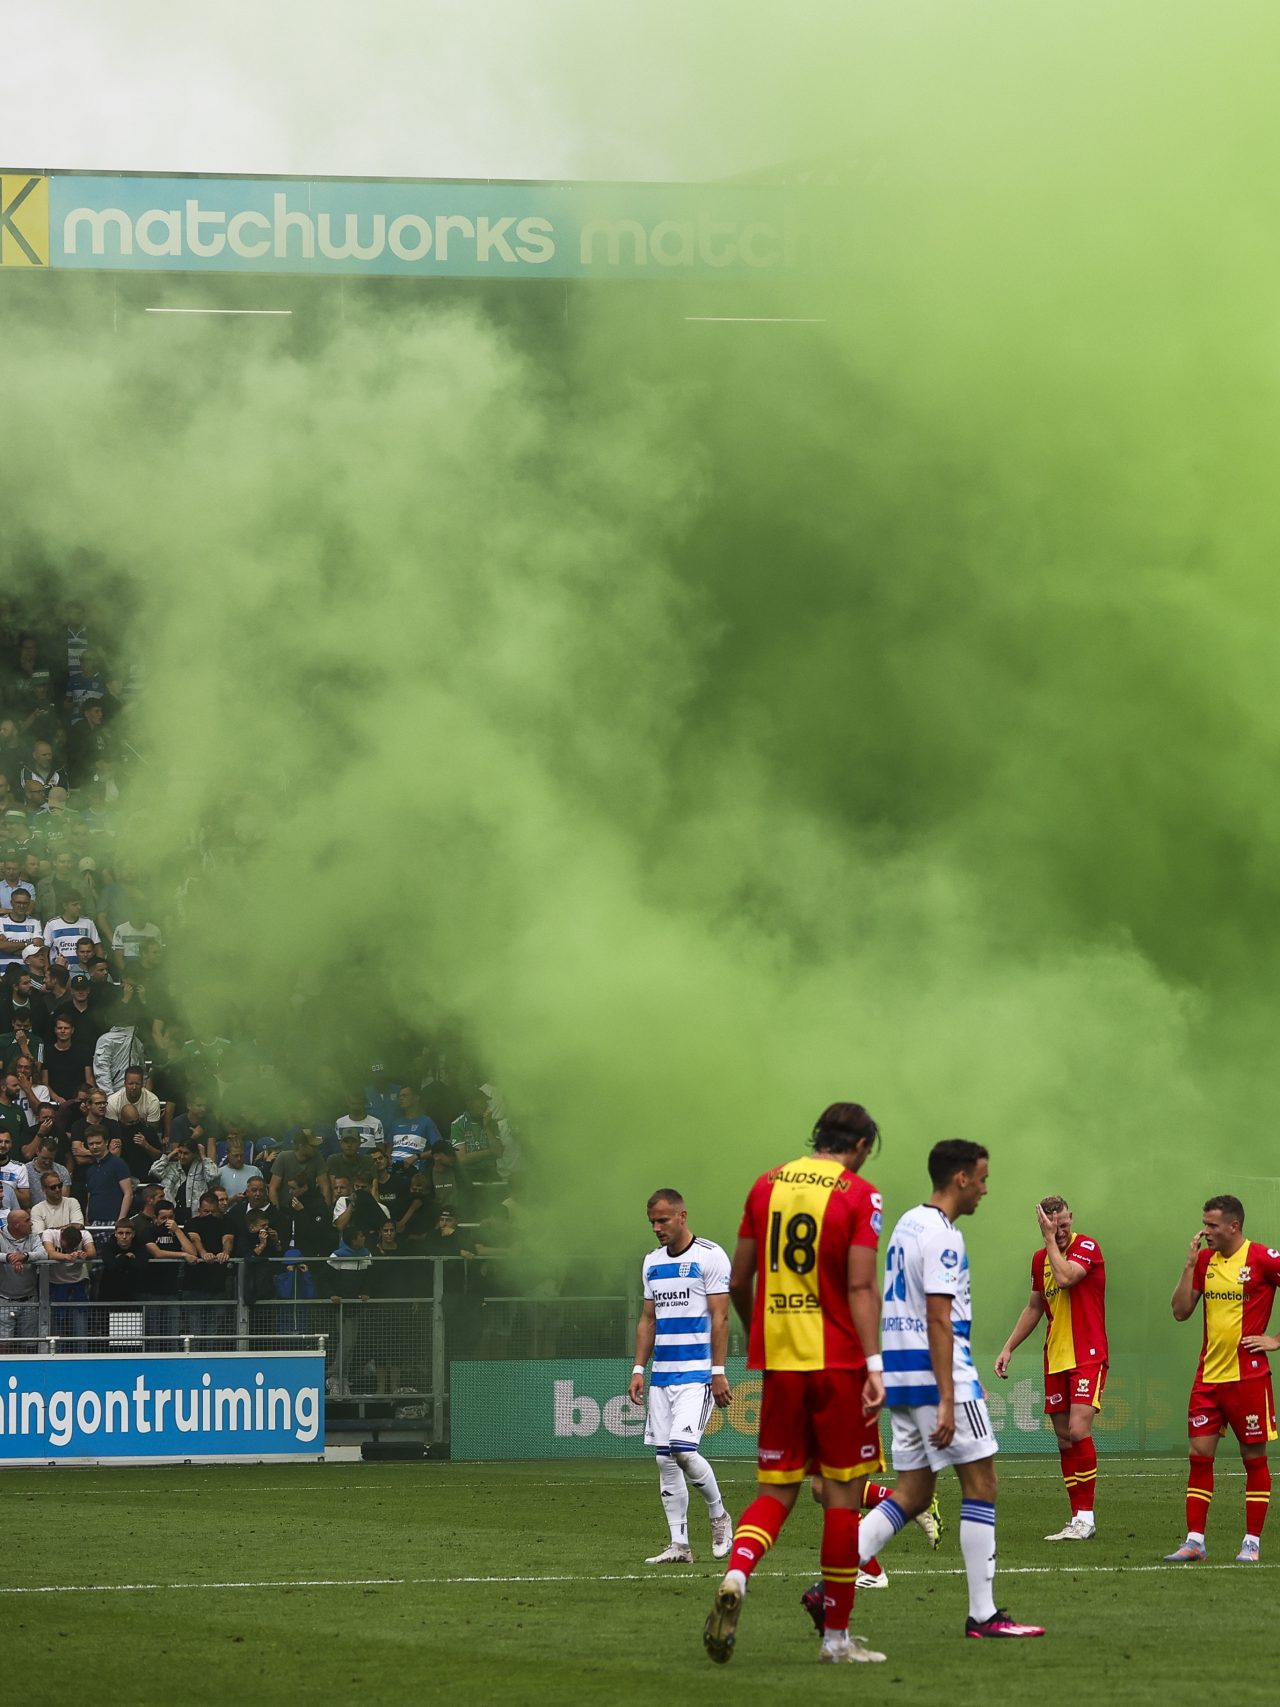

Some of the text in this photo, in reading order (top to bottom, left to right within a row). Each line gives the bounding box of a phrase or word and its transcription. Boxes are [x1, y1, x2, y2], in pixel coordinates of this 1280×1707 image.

[63, 193, 556, 264] matchworks
[768, 1169, 849, 1192] VALIDSIGN
[770, 1211, 817, 1275] 18
[1204, 1290, 1249, 1301] etnation
